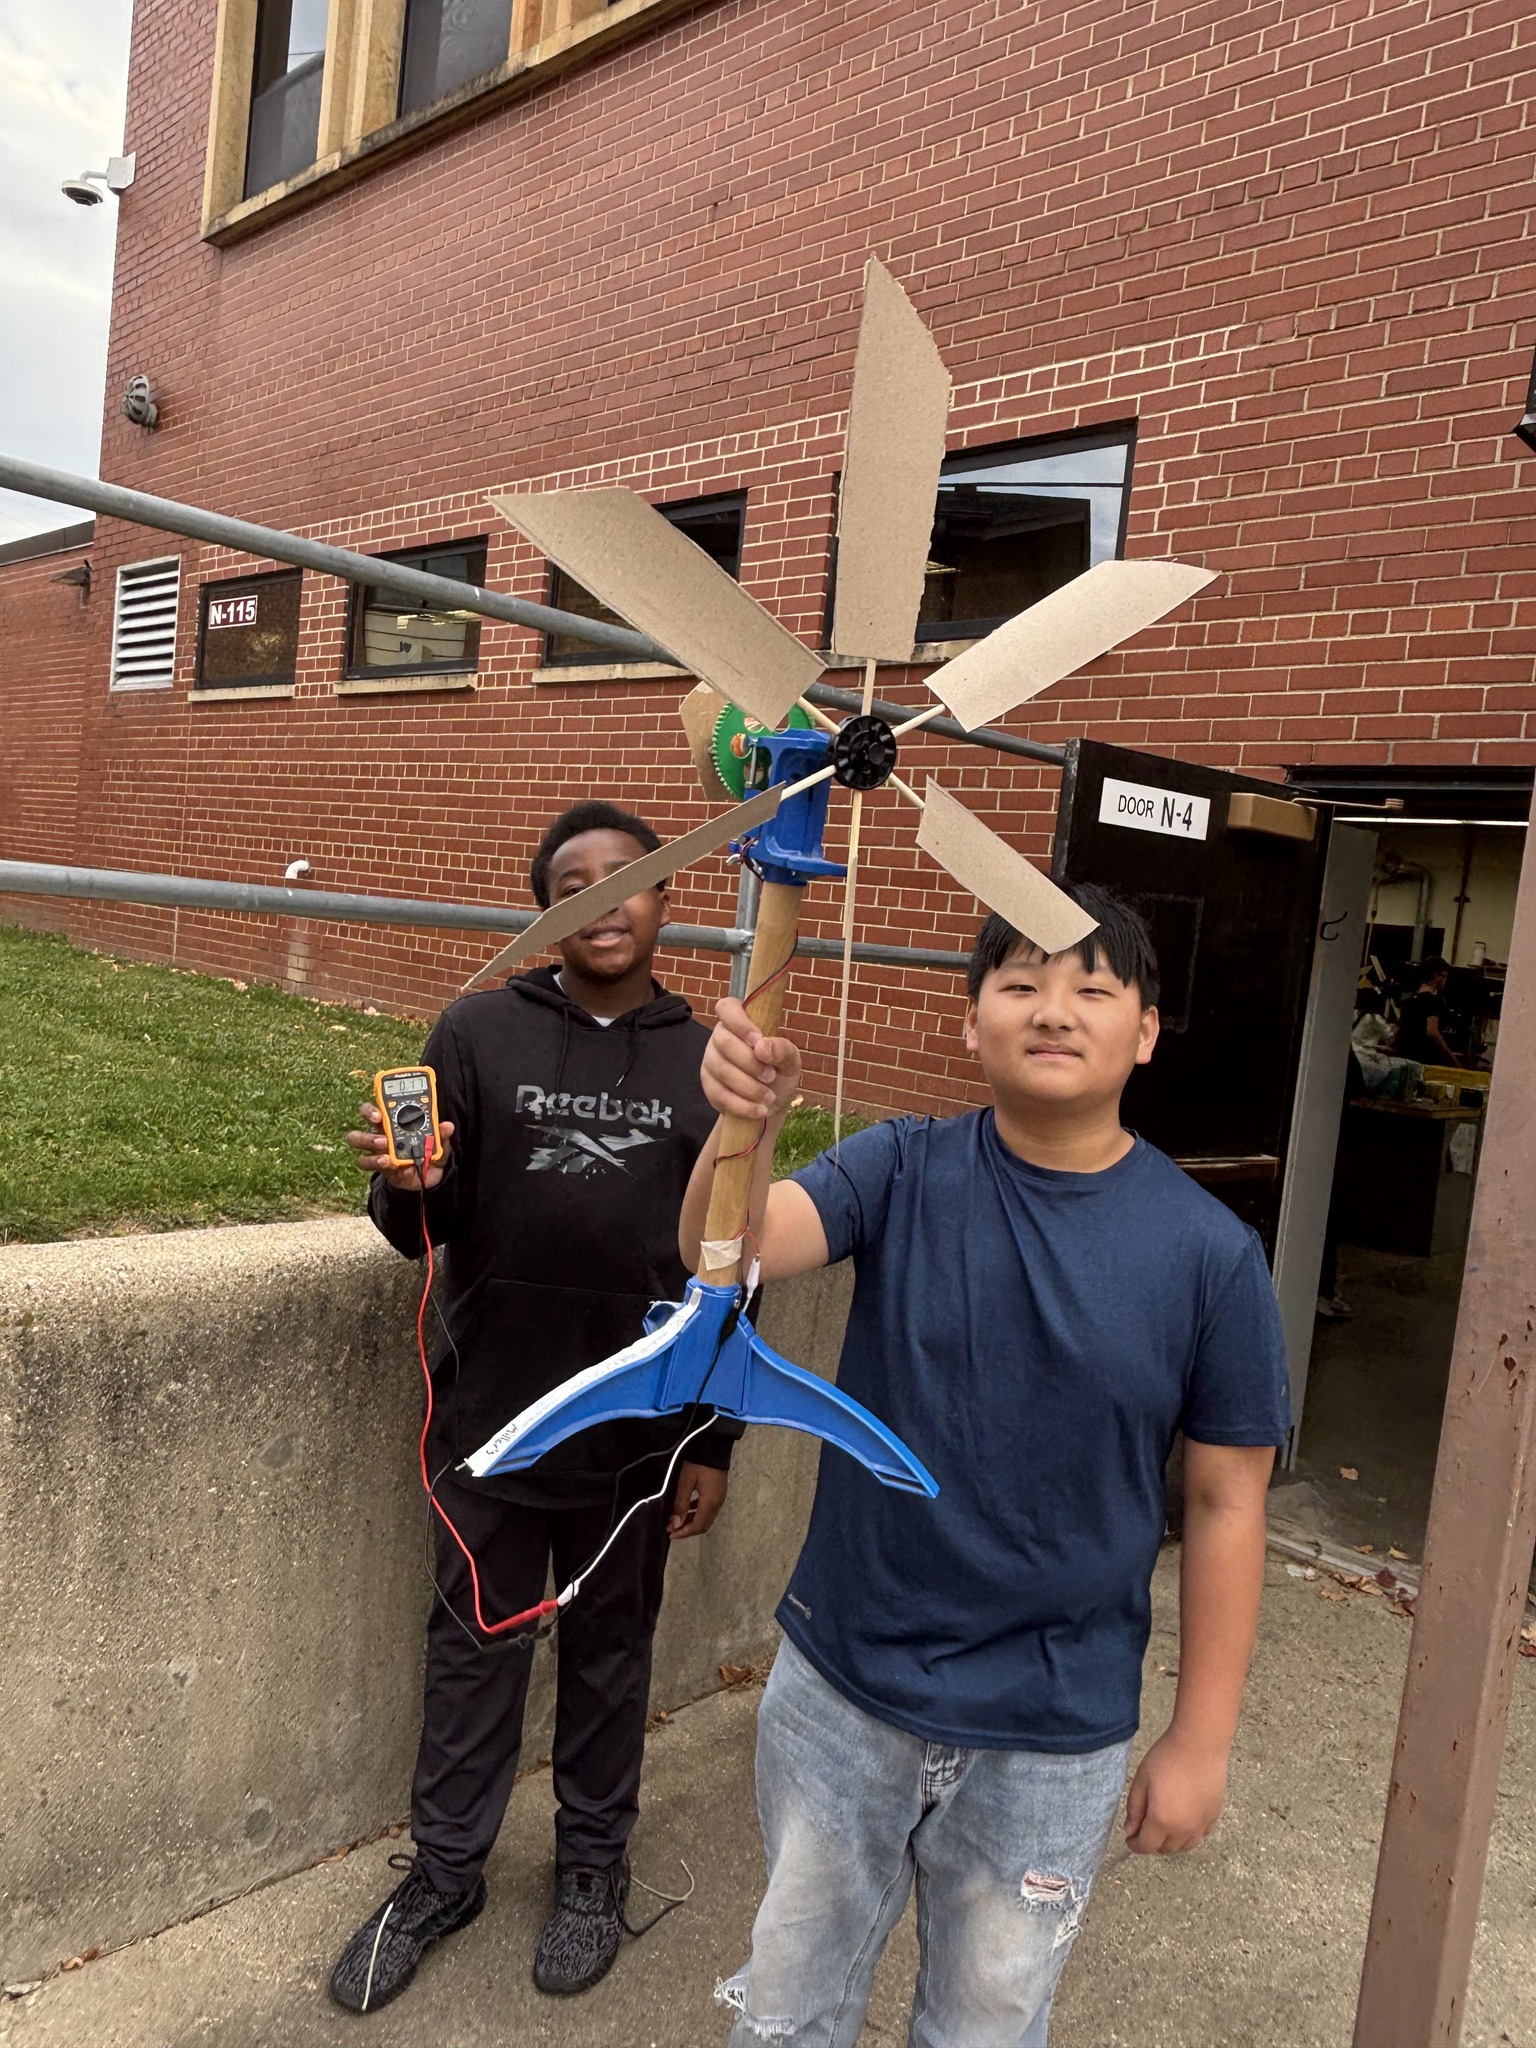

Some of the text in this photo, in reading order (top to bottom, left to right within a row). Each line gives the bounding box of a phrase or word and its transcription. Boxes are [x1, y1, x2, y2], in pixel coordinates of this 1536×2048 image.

[210, 600, 255, 625] N-115
[1117, 794, 1193, 831] DOOR N-4
[515, 1084, 672, 1128] Reebok
